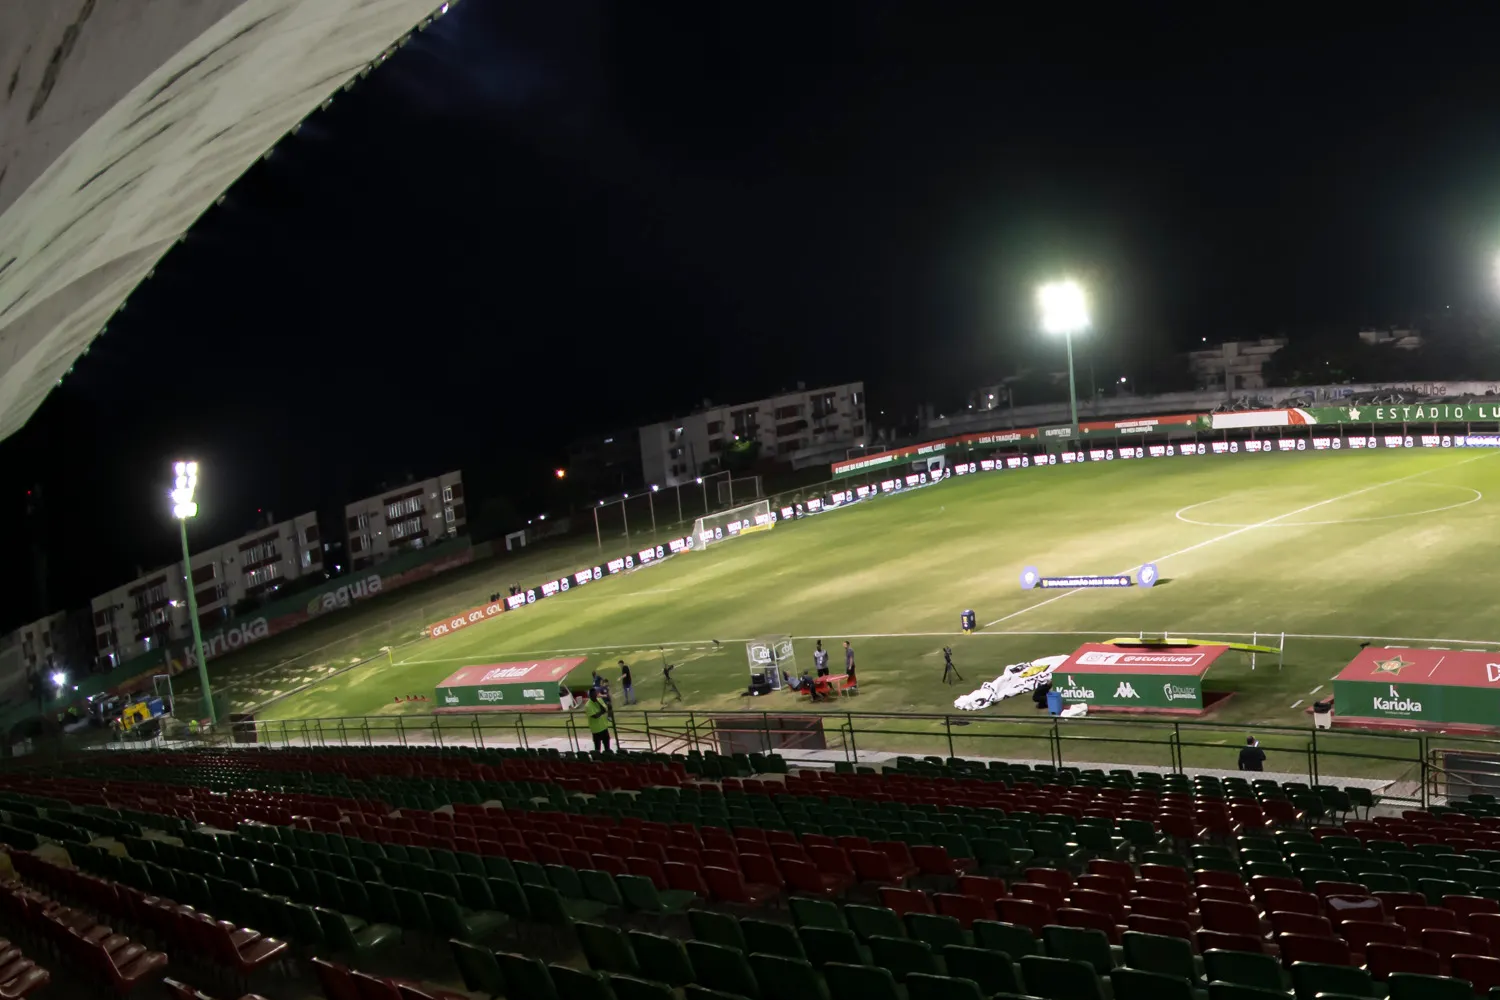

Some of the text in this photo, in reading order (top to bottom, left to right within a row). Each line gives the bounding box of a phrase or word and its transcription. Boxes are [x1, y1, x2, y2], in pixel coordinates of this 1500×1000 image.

[1376, 405, 1463, 419] ESTÁDIO
[433, 624, 449, 637] GOL
[451, 617, 467, 629] GOL
[469, 610, 484, 622] GOL
[486, 603, 502, 616] GOL
[478, 689, 503, 701] Kappa
[1373, 696, 1422, 712] Karioka
